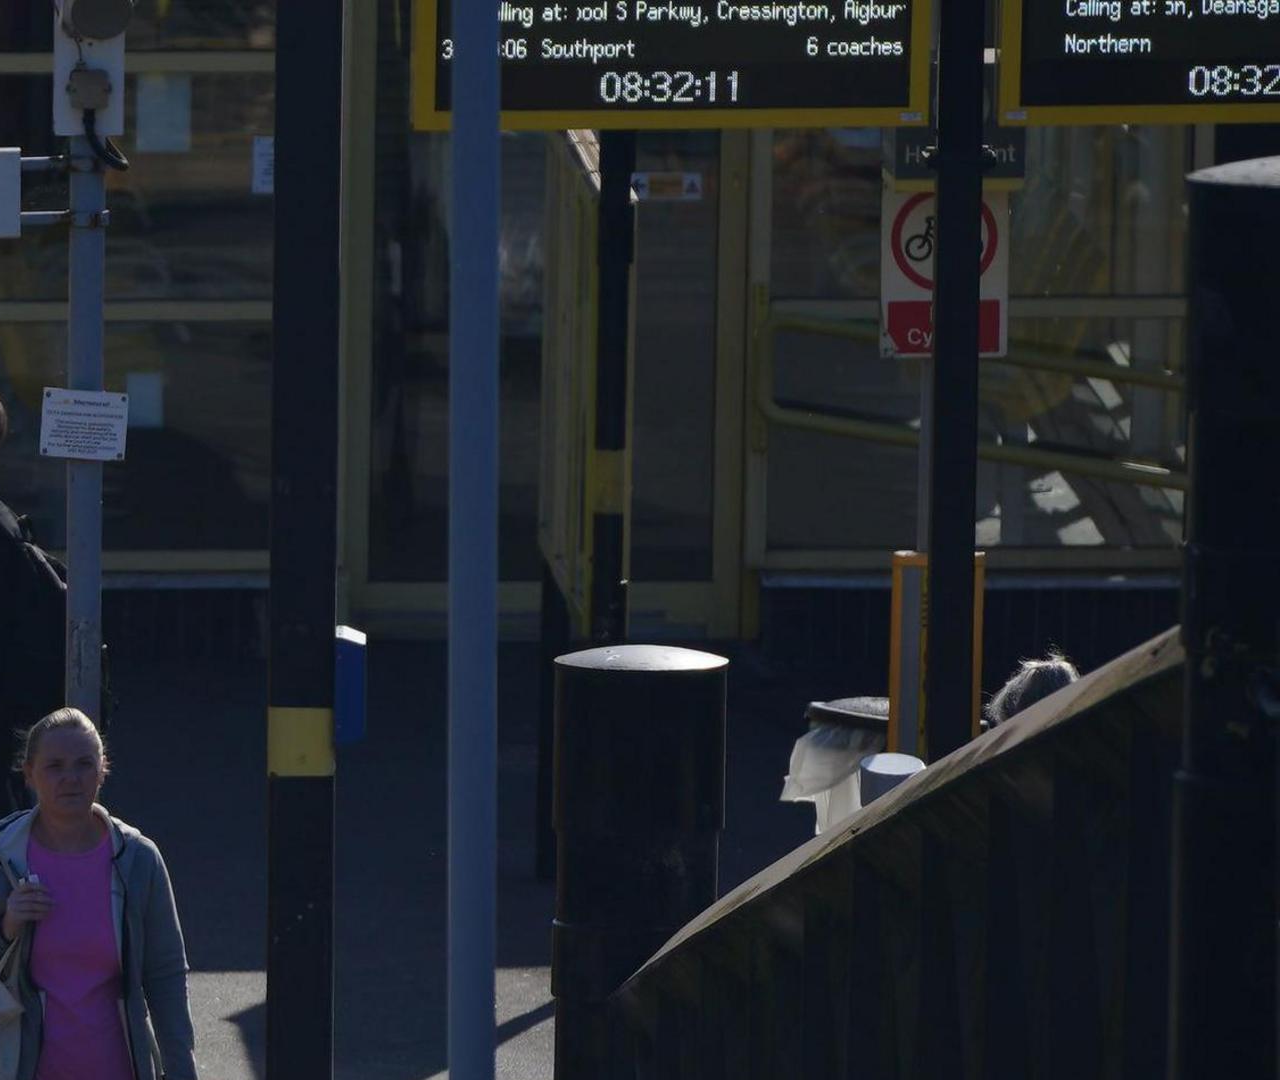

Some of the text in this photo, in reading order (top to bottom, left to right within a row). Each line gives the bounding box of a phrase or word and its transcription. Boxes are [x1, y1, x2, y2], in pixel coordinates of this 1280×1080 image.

[498, 1, 534, 28] lling
[542, 3, 568, 21] at:
[616, 1, 628, 21] S
[636, 1, 709, 27] Parkwy,
[717, 0, 836, 26] Cressington,
[844, 0, 907, 25] Aigbur
[1065, 0, 1122, 21] Calling
[1131, 0, 1157, 16] at:
[542, 38, 636, 64] Southport
[806, 36, 819, 56] 6
[827, 36, 904, 56] coaches
[1065, 33, 1152, 53] Northern
[600, 71, 739, 102] 08:32:11
